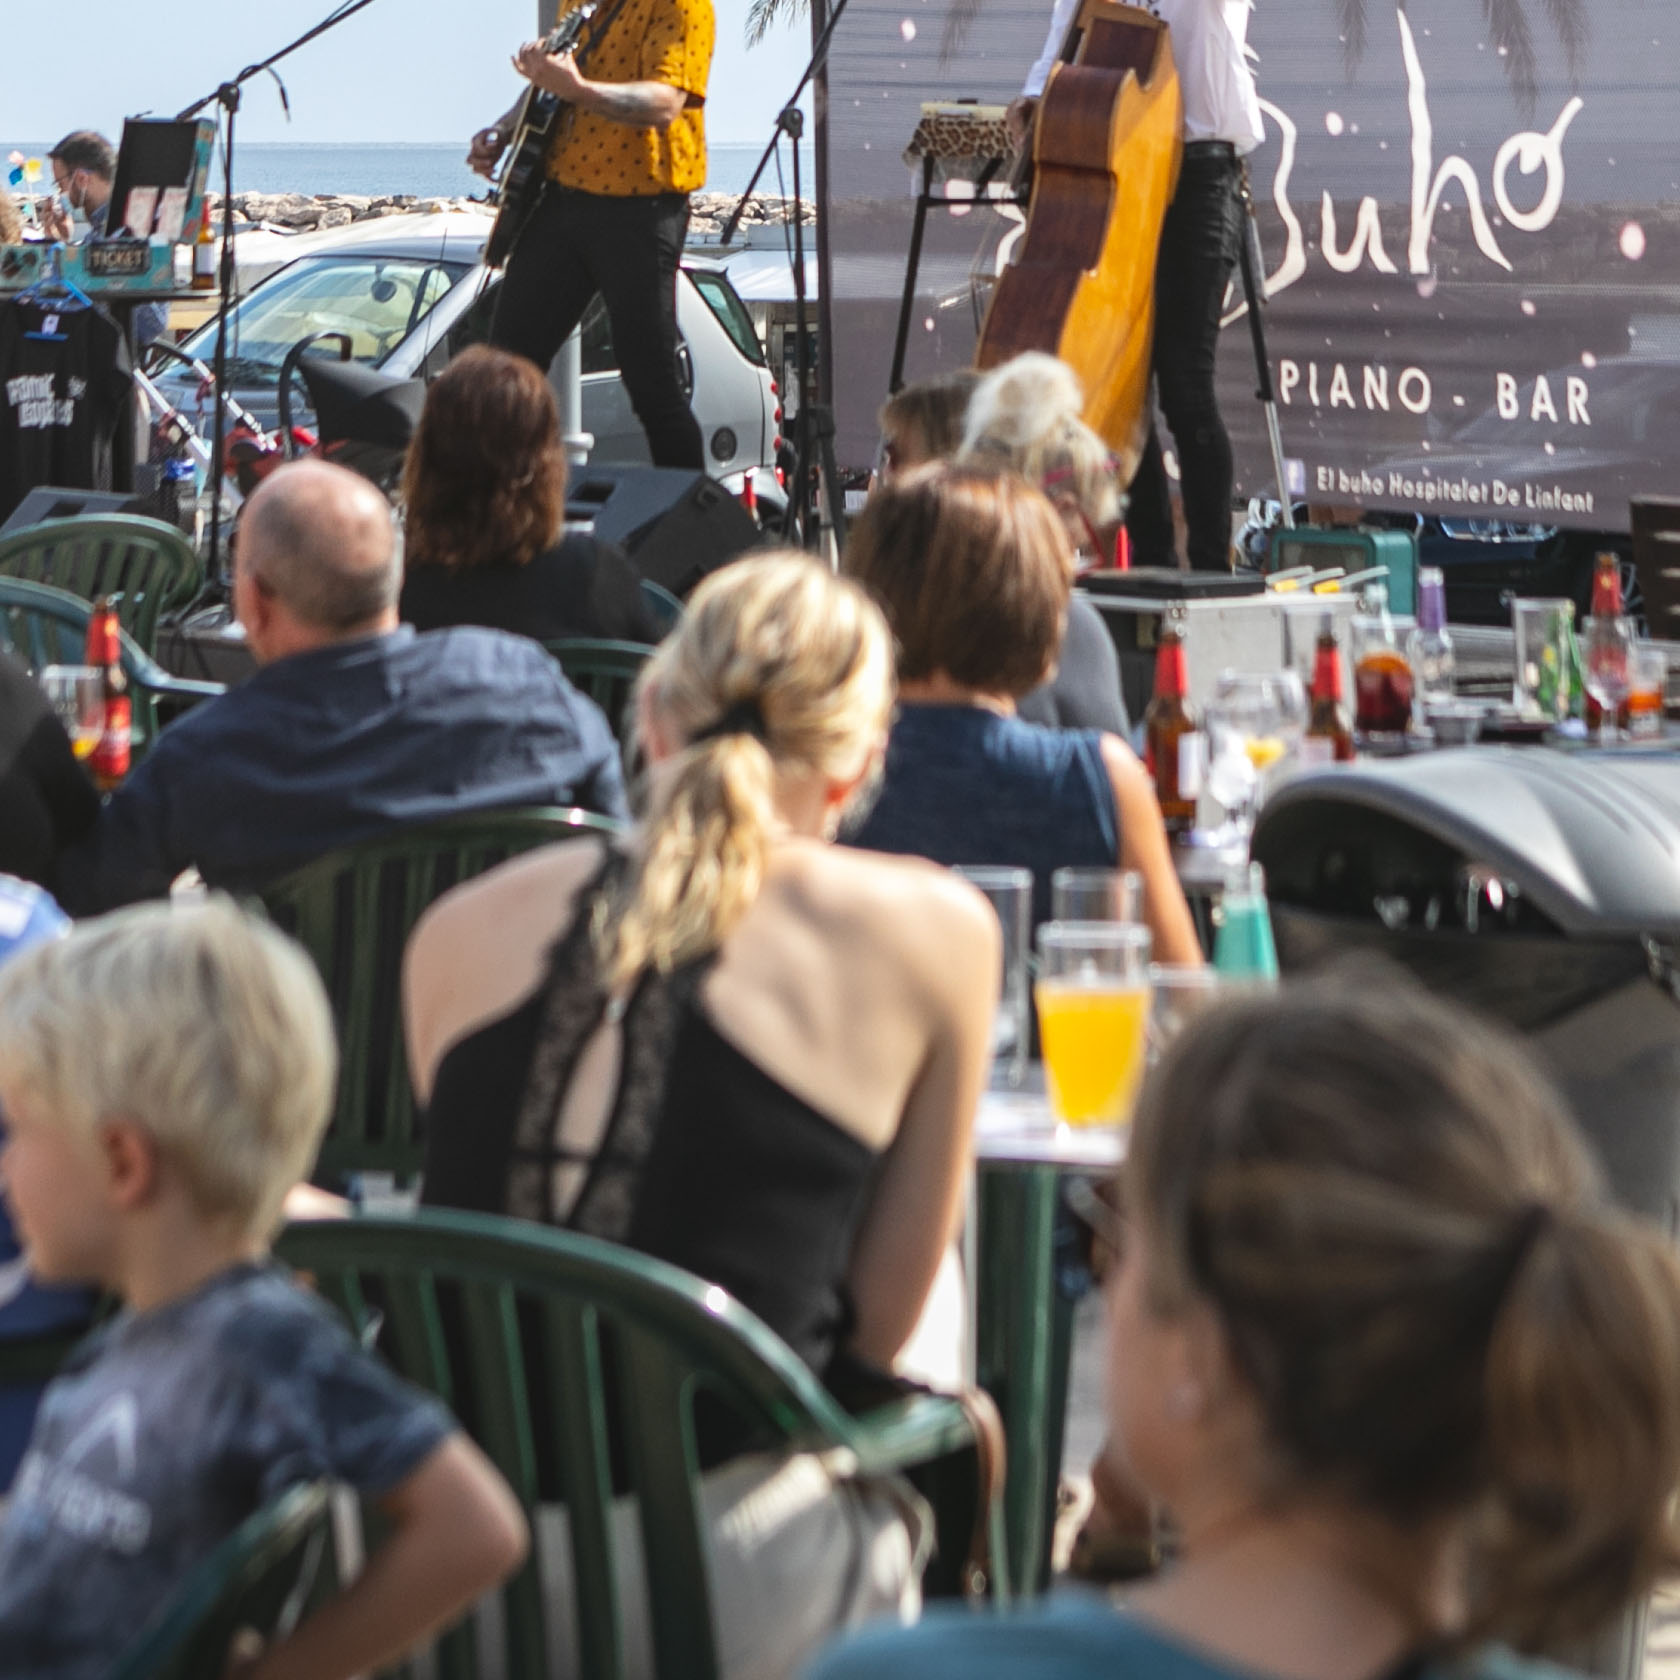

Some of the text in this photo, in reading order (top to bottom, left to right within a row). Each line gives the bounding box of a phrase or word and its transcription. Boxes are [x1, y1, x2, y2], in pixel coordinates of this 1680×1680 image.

[1279, 359, 1432, 414] PIANO
[1496, 372, 1592, 426] BAR
[1317, 465, 1335, 491] El
[1339, 469, 1385, 496] buho
[1388, 472, 1489, 504] Hospitalet
[1492, 479, 1521, 507] De
